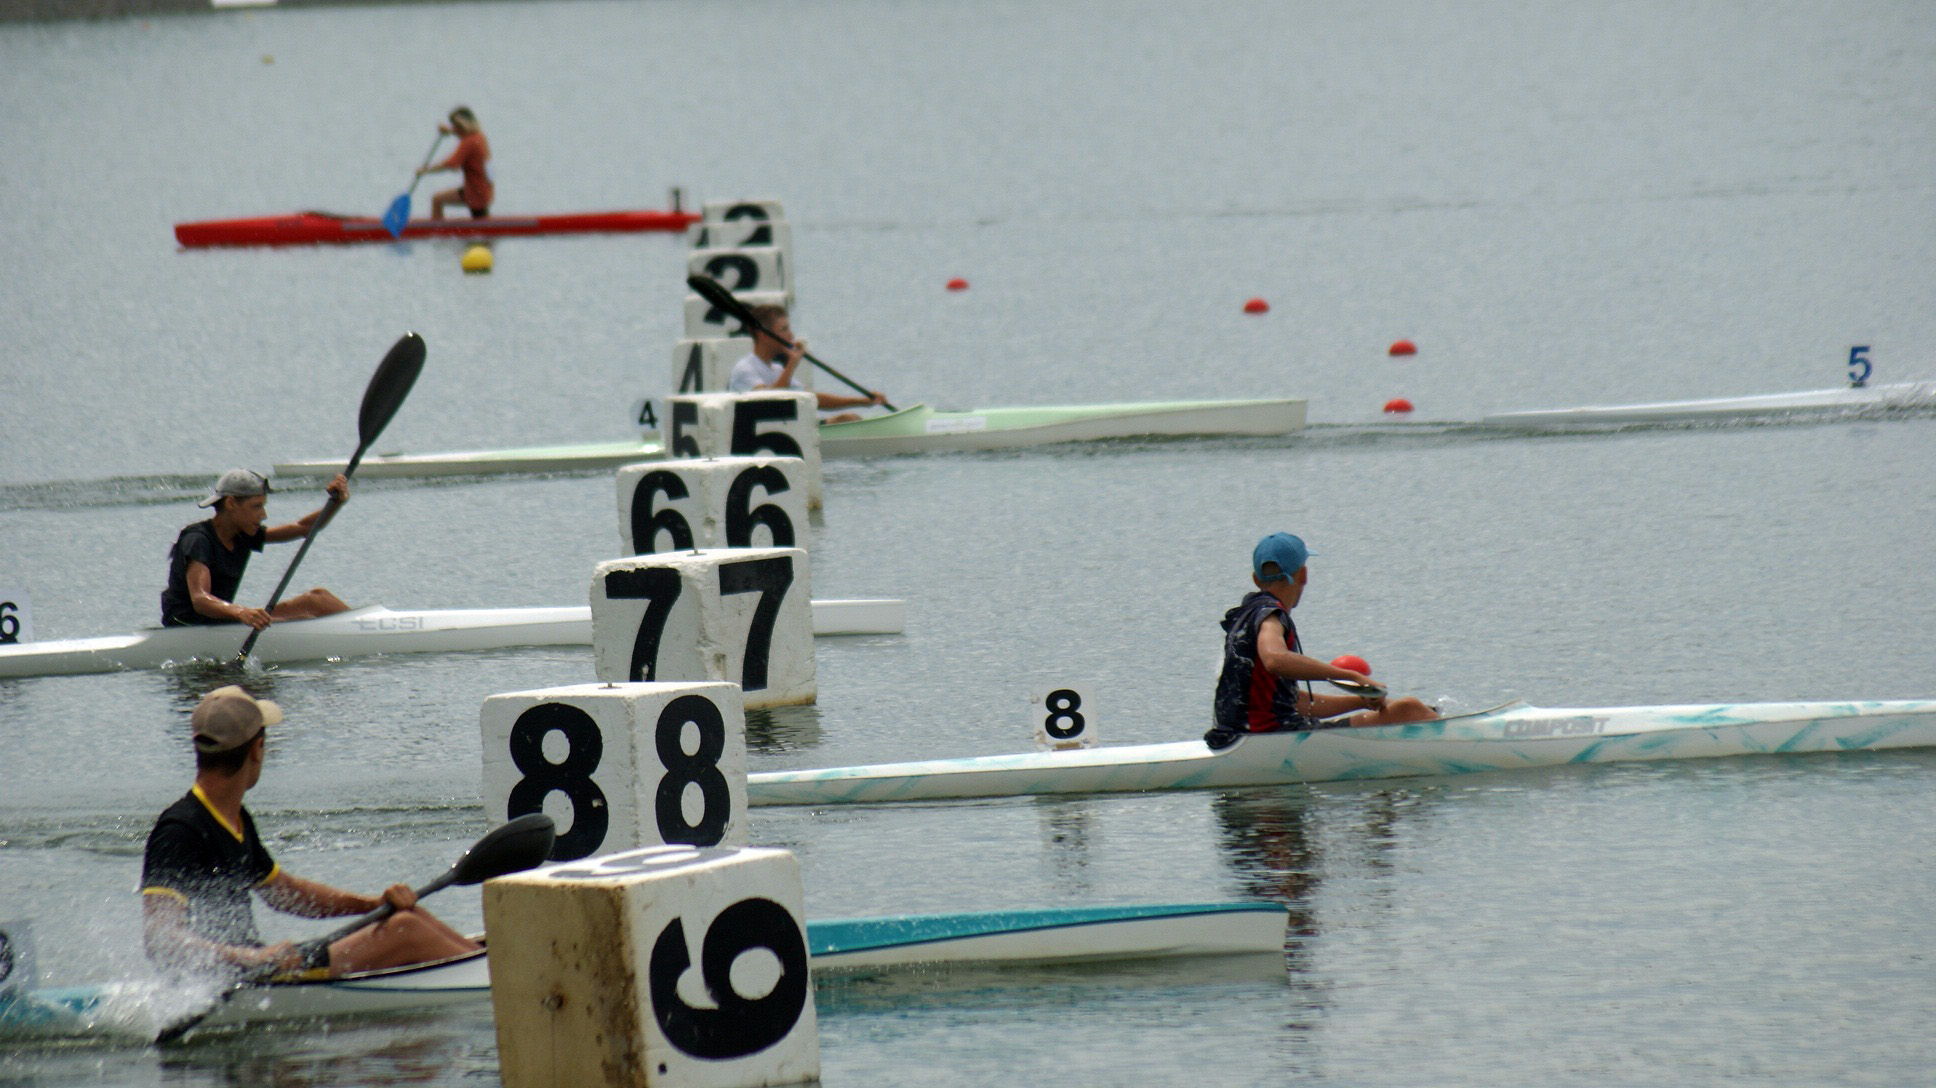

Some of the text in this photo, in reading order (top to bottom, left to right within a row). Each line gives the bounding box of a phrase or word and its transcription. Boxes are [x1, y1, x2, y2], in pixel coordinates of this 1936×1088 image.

[1847, 345, 1873, 383] 5
[638, 400, 659, 429] 4
[672, 401, 700, 457] 5
[730, 398, 804, 460] 5
[630, 469, 694, 556] 6
[725, 464, 795, 549] 6
[0, 601, 20, 638] 6
[604, 566, 682, 682] 7
[718, 556, 794, 692] 7
[1045, 688, 1086, 740] 8
[507, 702, 609, 862] 8
[655, 694, 731, 848] 8
